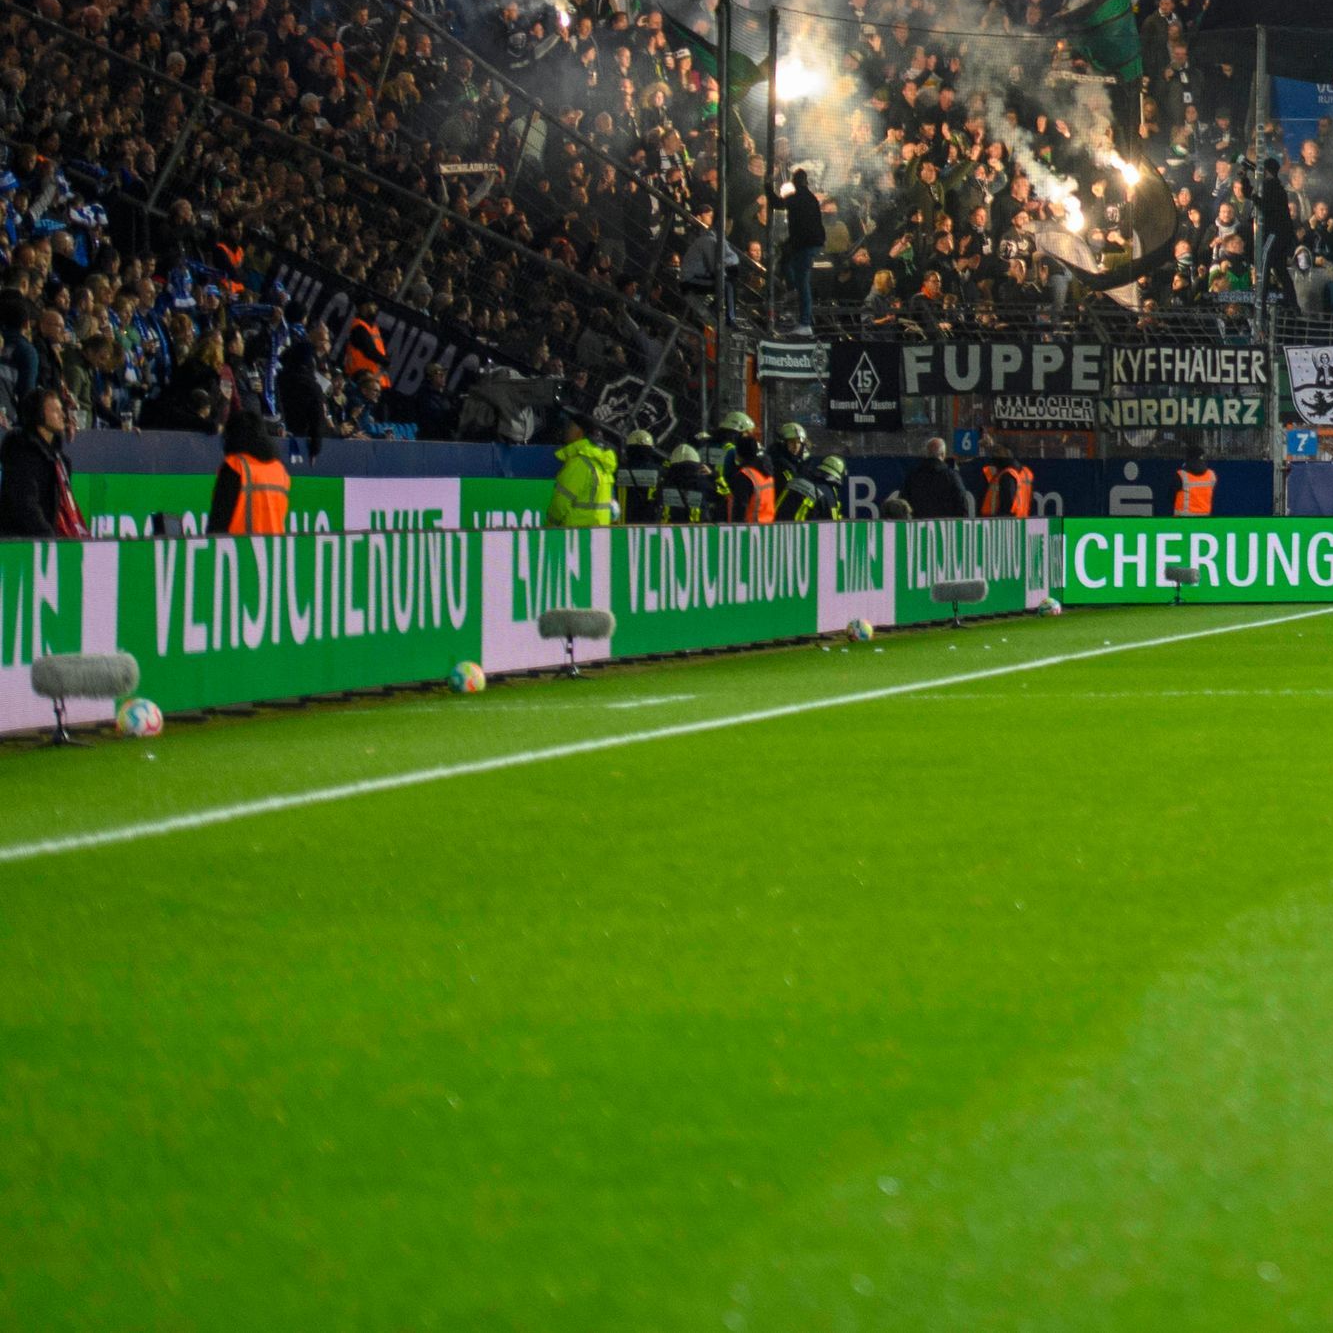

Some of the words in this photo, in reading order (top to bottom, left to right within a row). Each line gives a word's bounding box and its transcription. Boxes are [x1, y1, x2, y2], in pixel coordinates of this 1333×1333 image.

[902, 344, 1101, 394] FUPPE
[1112, 346, 1267, 385] KYFFHÄUSER
[856, 370, 873, 388] 15
[994, 396, 1094, 419] MALOCHER
[1098, 397, 1262, 427] NORDHARZ
[961, 432, 973, 451] 6
[1296, 432, 1309, 452] 7
